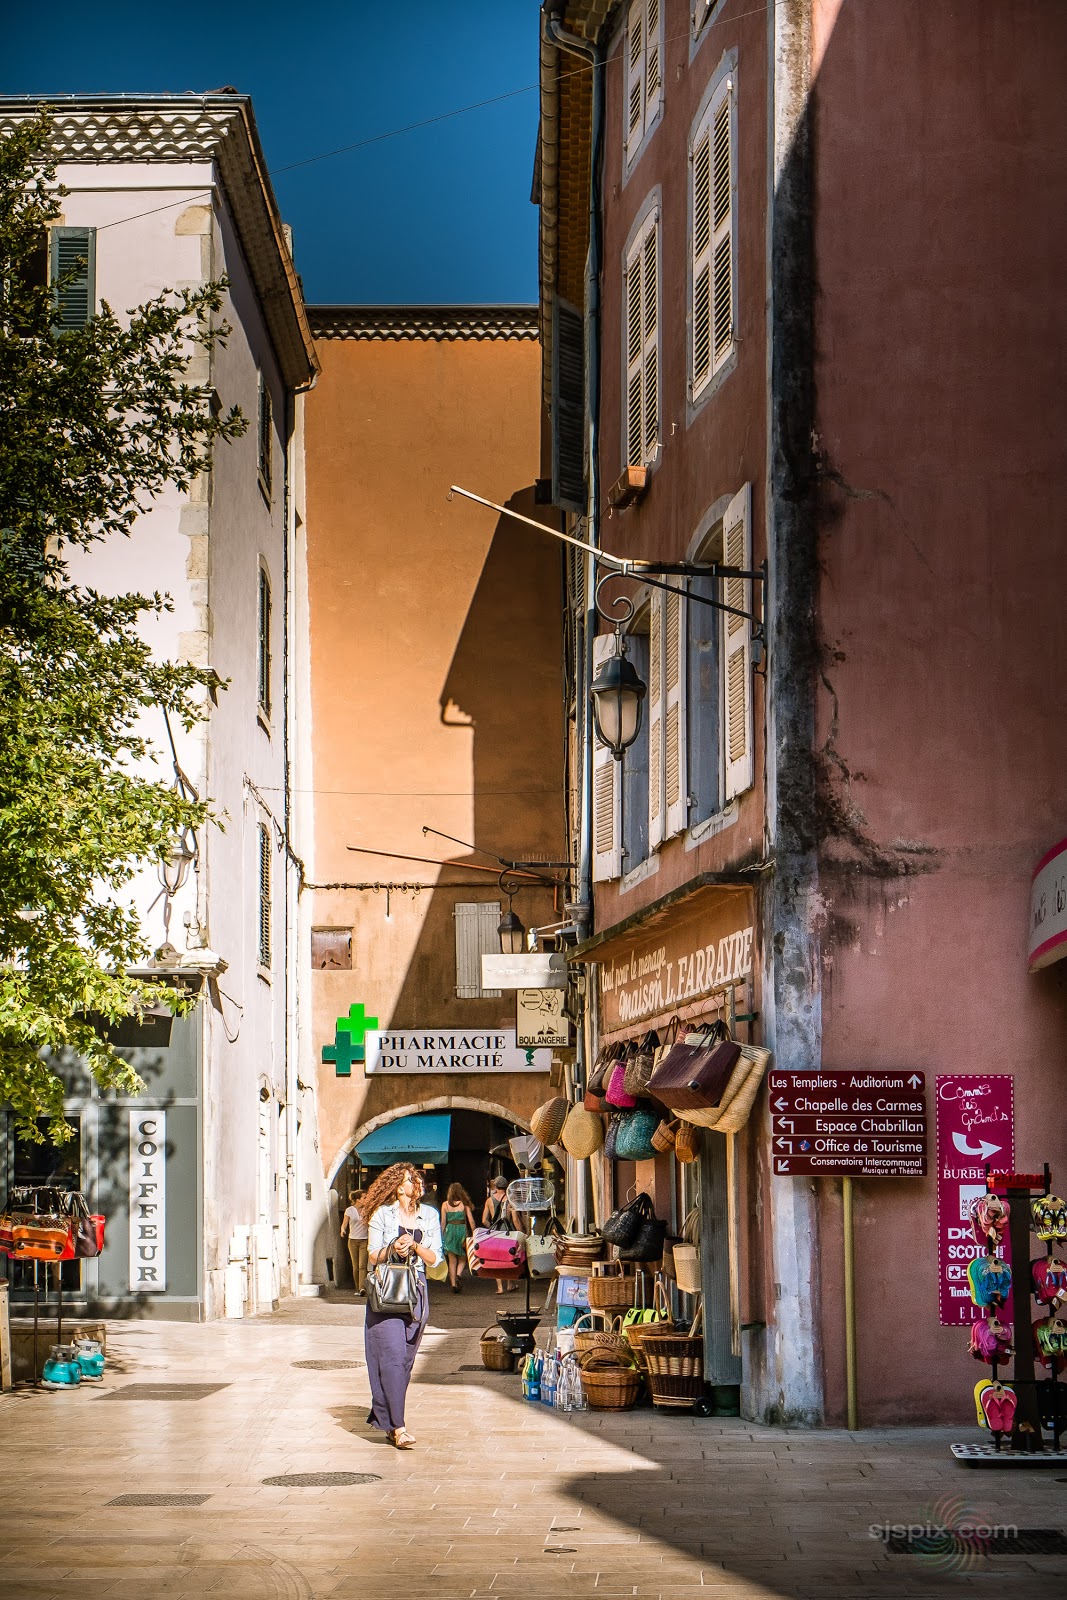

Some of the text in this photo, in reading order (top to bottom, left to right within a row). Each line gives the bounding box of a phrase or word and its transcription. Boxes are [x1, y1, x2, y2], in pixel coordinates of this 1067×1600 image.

[676, 926, 754, 1001] FARRAYRE
[601, 959, 615, 993] tout
[615, 963, 629, 996] pour
[630, 950, 637, 981] le
[378, 1035, 507, 1050] PHARMACIE
[519, 1035, 567, 1045] BOULANGERIE
[381, 1053, 503, 1068] DU MARCHÉ
[771, 1075, 788, 1088] Les
[791, 1075, 838, 1091] Templiers
[849, 1074, 904, 1089] Auditorium
[794, 1097, 923, 1114] Chapelle des Carmes
[815, 1119, 924, 1135] Espace Chabrillan
[814, 1138, 923, 1153] Office de Tourisme
[810, 1156, 922, 1168] Conservatoire Intercommunal
[861, 1166, 889, 1176] Musique
[890, 1167, 897, 1175] et
[943, 1168, 1010, 1180] BURBE
[137, 1120, 158, 1282] COIFFEUR
[959, 1306, 998, 1319] ELL
